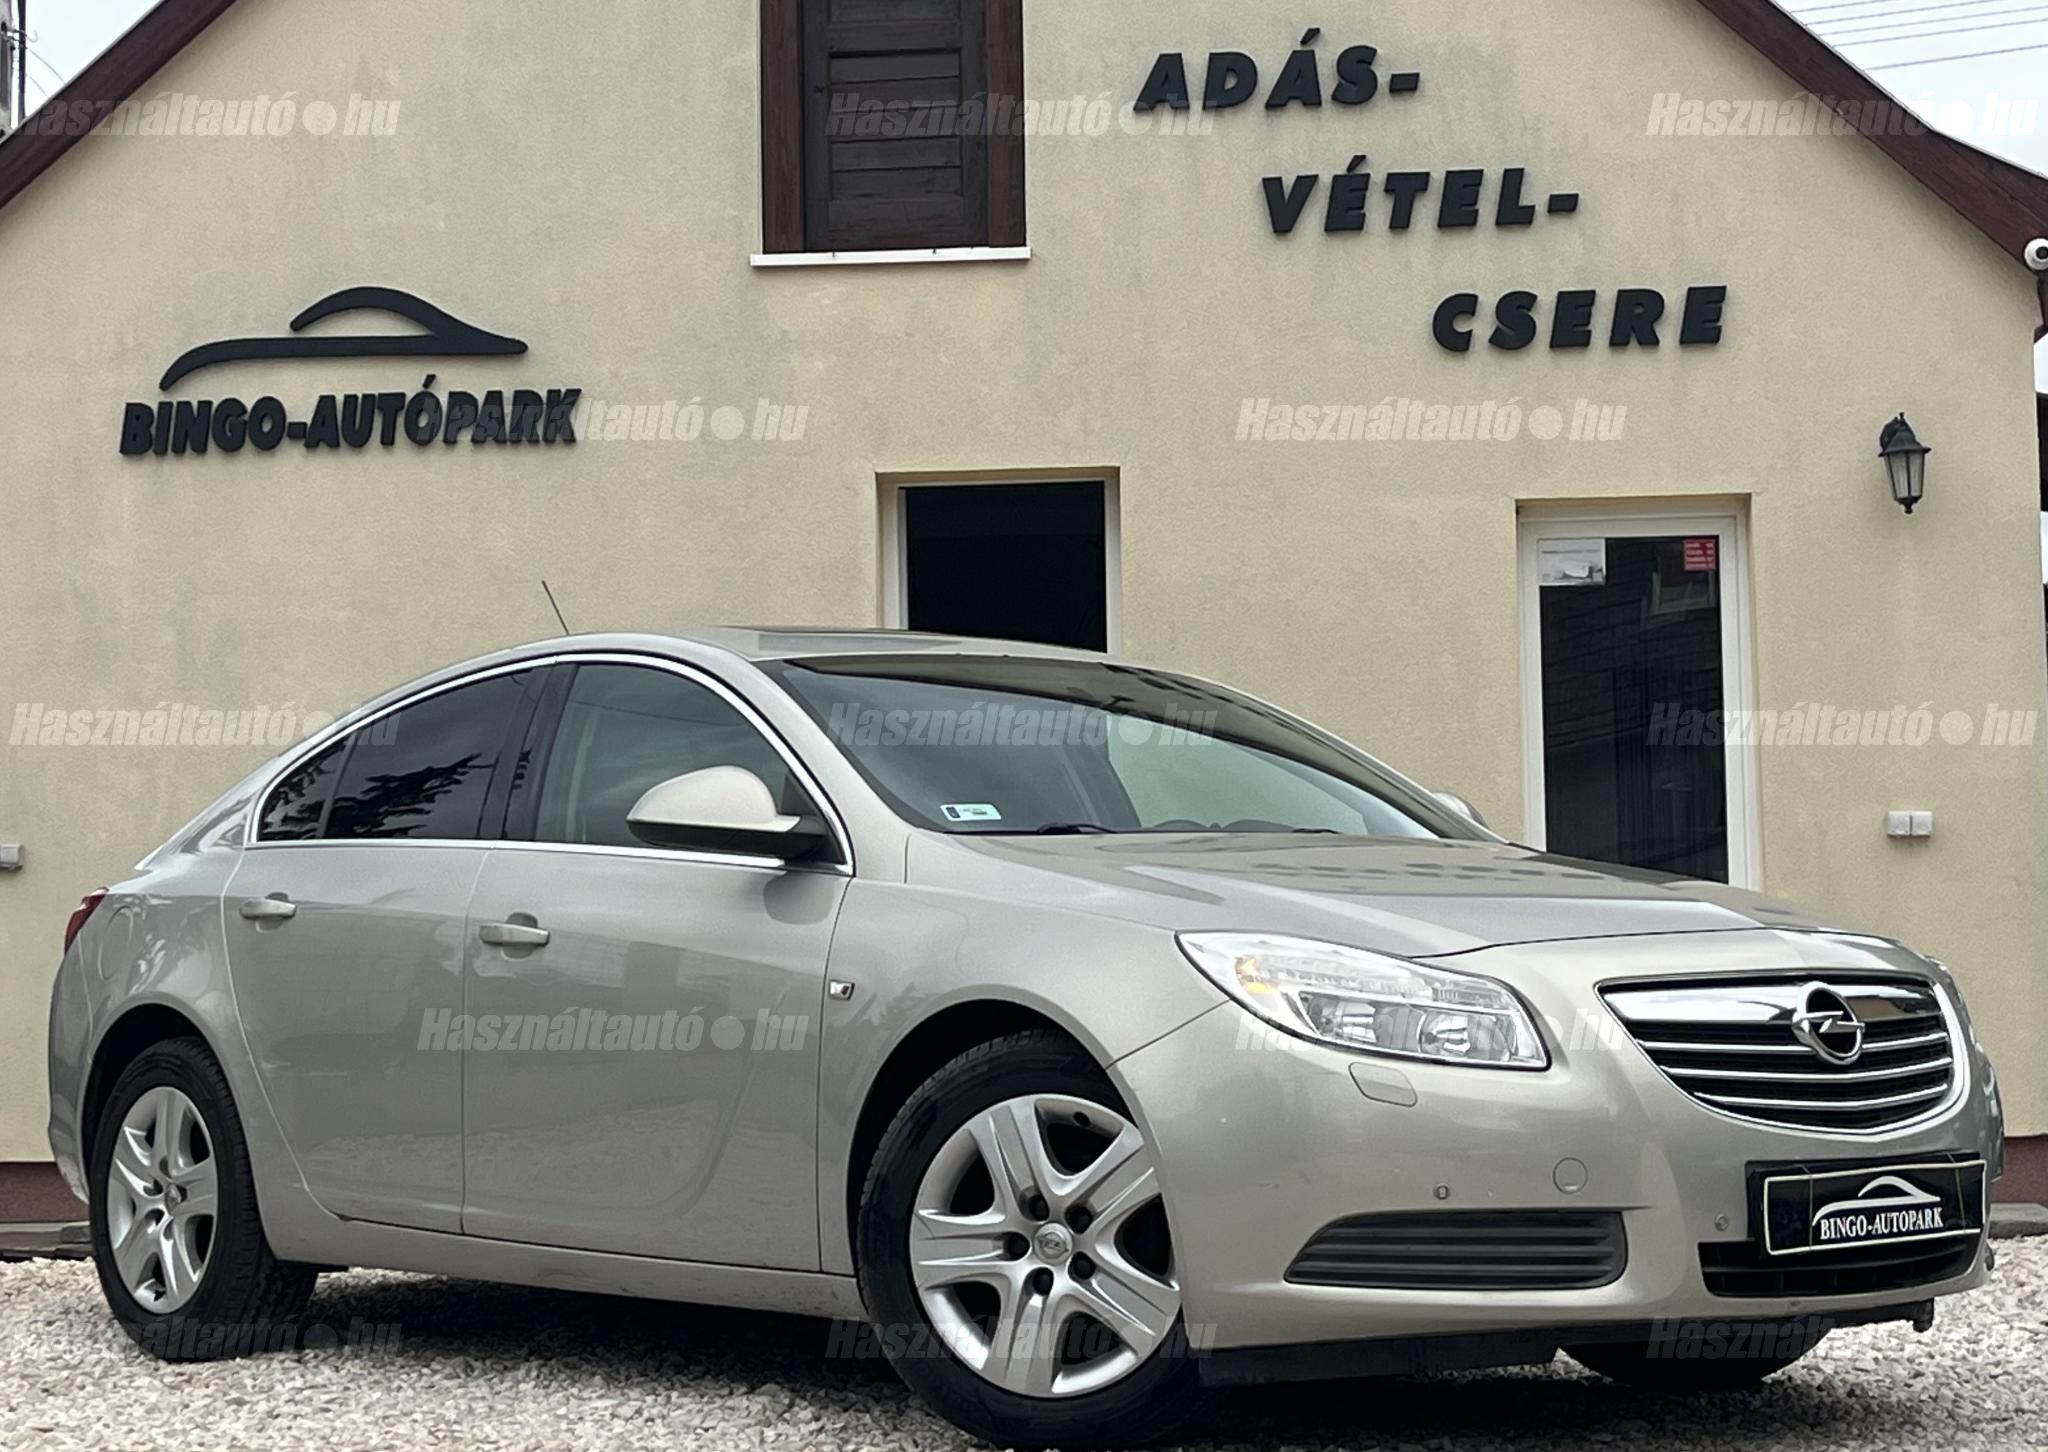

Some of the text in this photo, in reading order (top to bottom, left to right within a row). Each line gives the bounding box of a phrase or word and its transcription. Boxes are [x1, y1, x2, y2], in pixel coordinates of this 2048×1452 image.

[1134, 27, 1420, 111] ADÁS-
[1262, 155, 1579, 234] VÉTEL-
[1432, 285, 1728, 353] CSERE
[120, 374, 582, 456] BINGO-AUTÓPARK
[1820, 1207, 1944, 1241] BINGO-AUTOPARK
